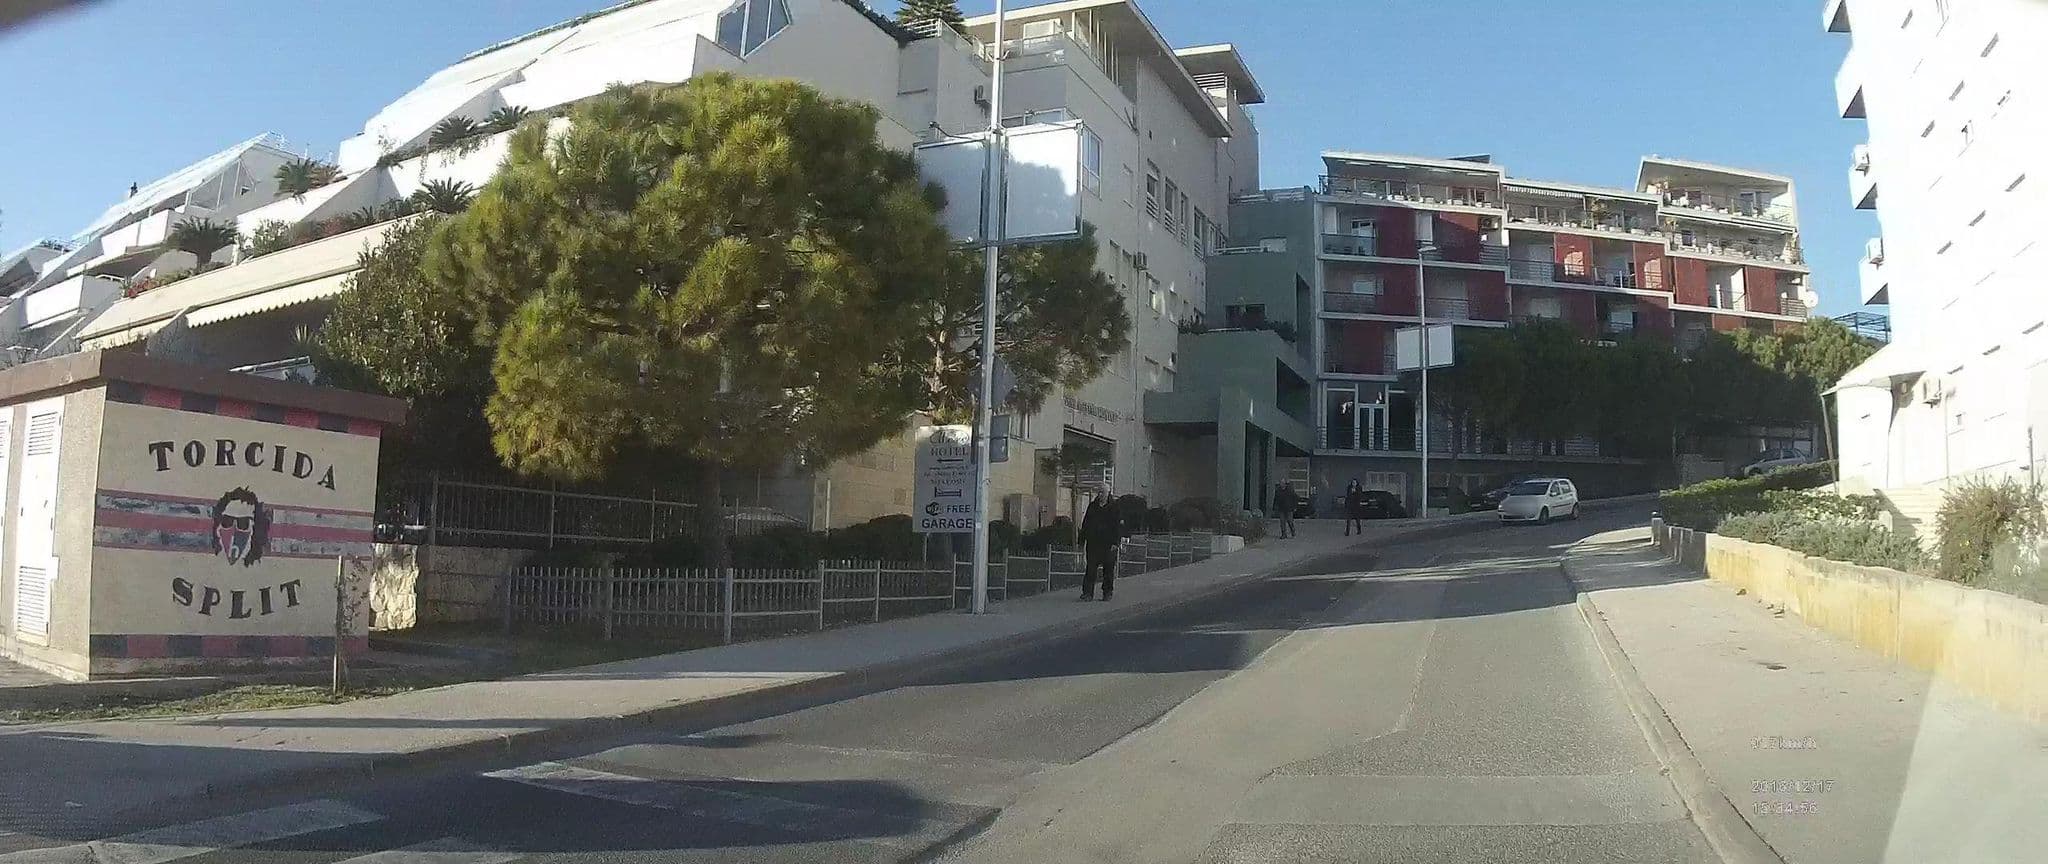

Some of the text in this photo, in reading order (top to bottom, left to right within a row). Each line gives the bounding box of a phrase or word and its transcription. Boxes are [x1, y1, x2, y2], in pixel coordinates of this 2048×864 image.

[930, 446, 969, 456] HOTEL
[148, 438, 336, 491] TORCIDA
[946, 504, 971, 513] FREE
[921, 518, 974, 529] GARAGE
[172, 577, 302, 619] SPLIT
